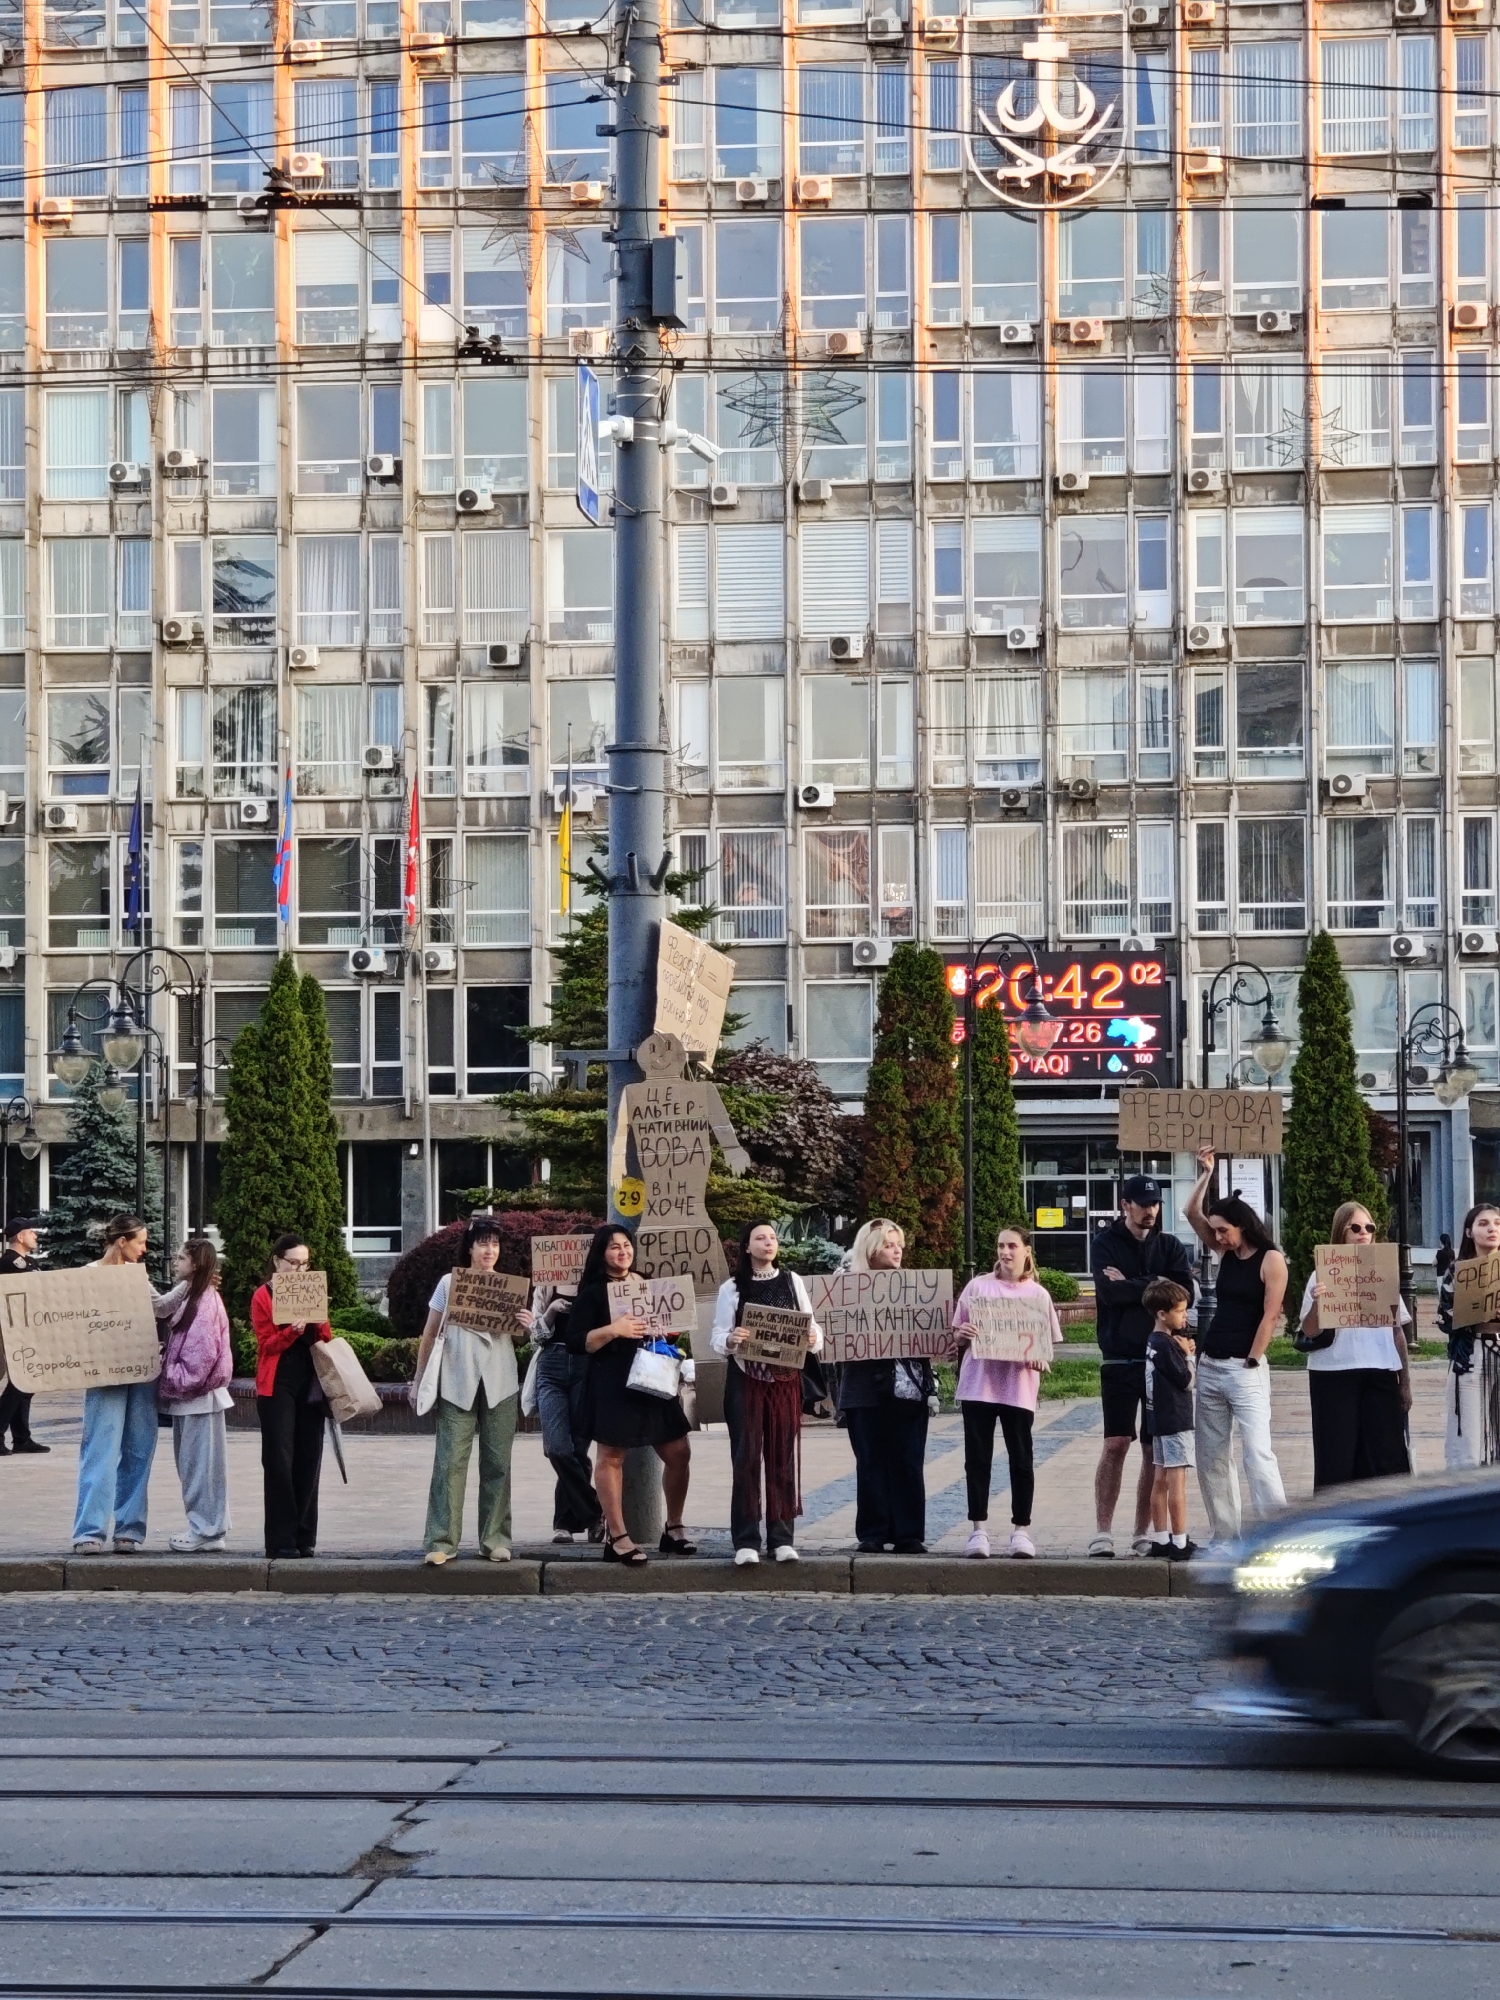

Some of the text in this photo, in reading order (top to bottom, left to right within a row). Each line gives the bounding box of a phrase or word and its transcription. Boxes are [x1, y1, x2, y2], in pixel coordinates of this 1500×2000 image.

[1130, 962, 1162, 984] 02
[1133, 1053, 1154, 1065] 100
[646, 1086, 673, 1104] ЦЕ
[1122, 1091, 1274, 1126] ФЕДОРОВА
[640, 1135, 706, 1169] ВОВА
[618, 1190, 641, 1207] 29
[652, 1181, 687, 1196] ВІН
[647, 1195, 696, 1217] ХОЧЕ
[1328, 1266, 1386, 1291] Федорова
[612, 1282, 648, 1299] ЦЕ Ж
[816, 1270, 939, 1310] ХЕРСОНУ
[5, 1291, 101, 1328] Полонених
[631, 1291, 685, 1318] БУЛО
[87, 1318, 132, 1335] додому
[844, 1332, 894, 1361] ВОНИ
[12, 1345, 81, 1379] Федорова
[83, 1368, 101, 1377] на
